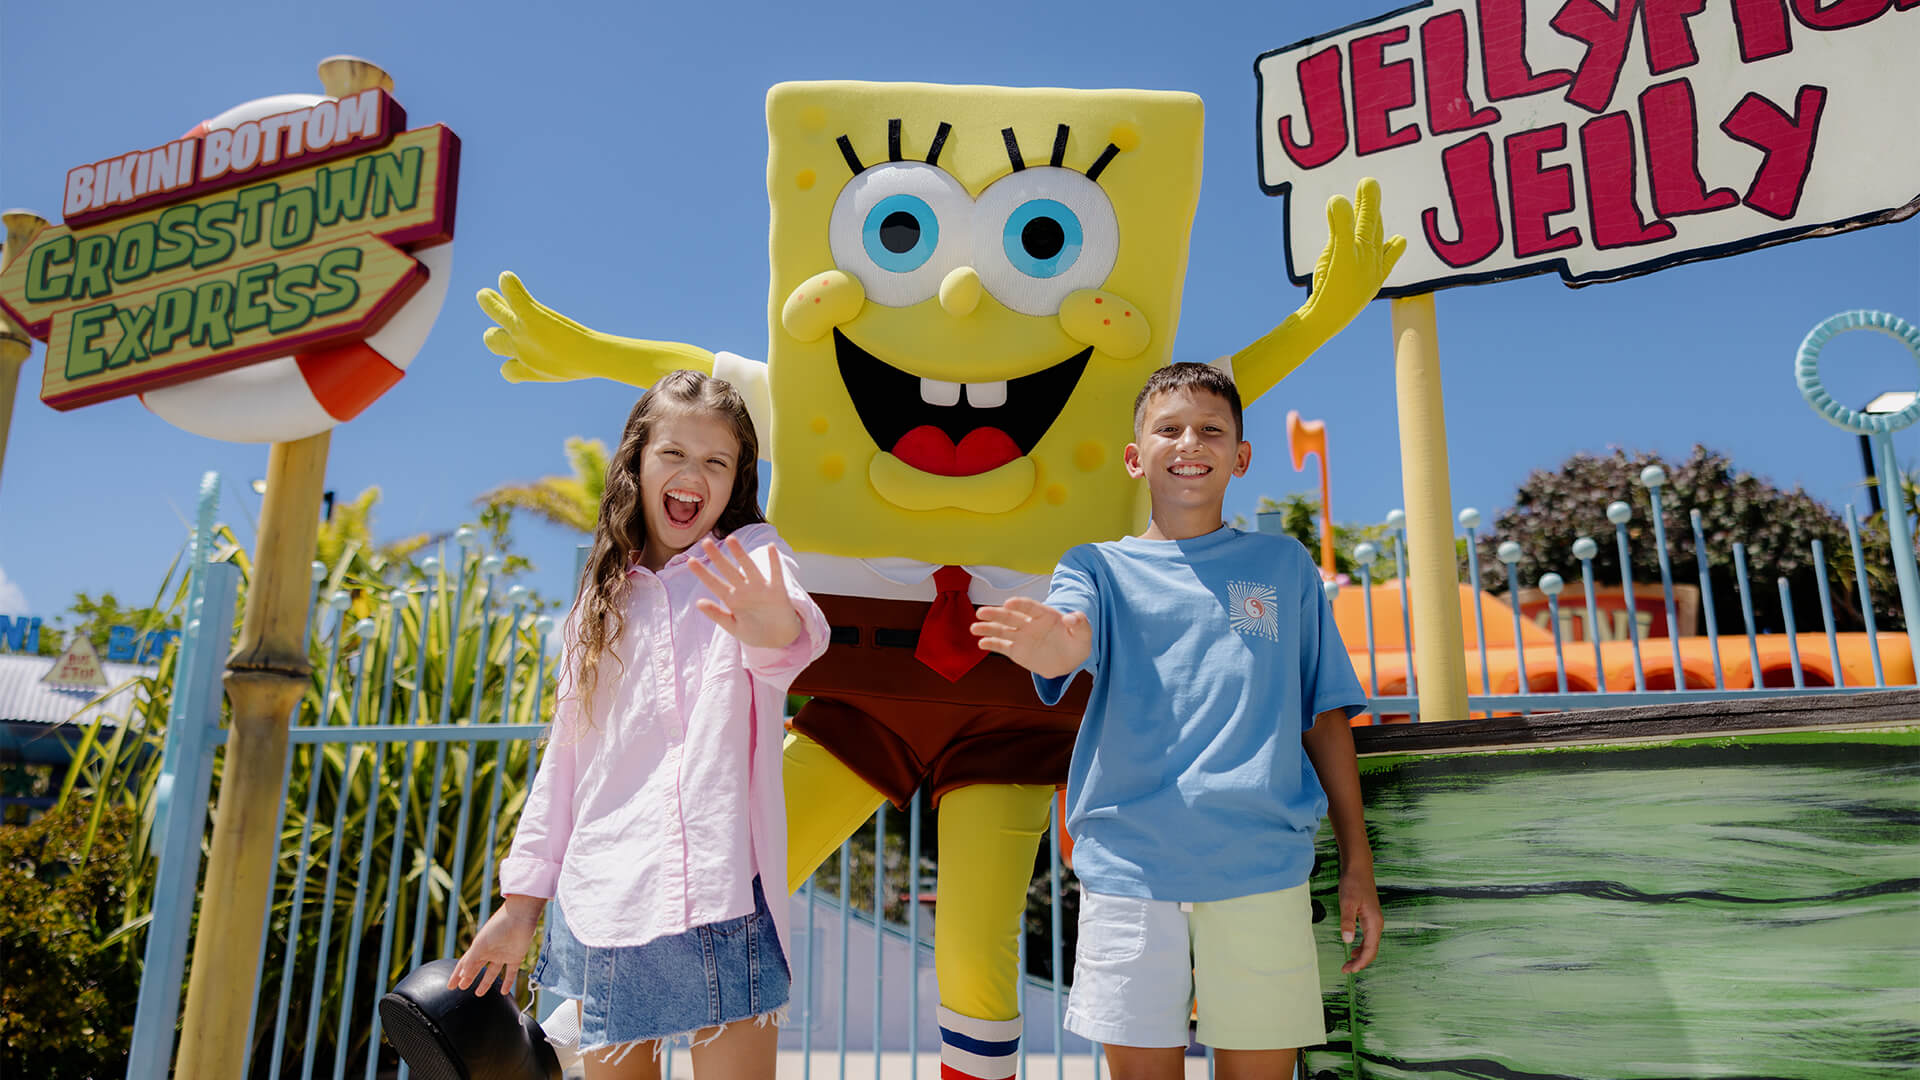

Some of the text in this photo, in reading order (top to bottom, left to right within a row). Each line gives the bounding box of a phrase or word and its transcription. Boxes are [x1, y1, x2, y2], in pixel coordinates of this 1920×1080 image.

[25, 146, 423, 302] CROSSTOWN
[63, 88, 383, 217] BIKINI BOTTOM
[1422, 77, 1828, 268] JELLY
[65, 247, 362, 381] EXPRESS
